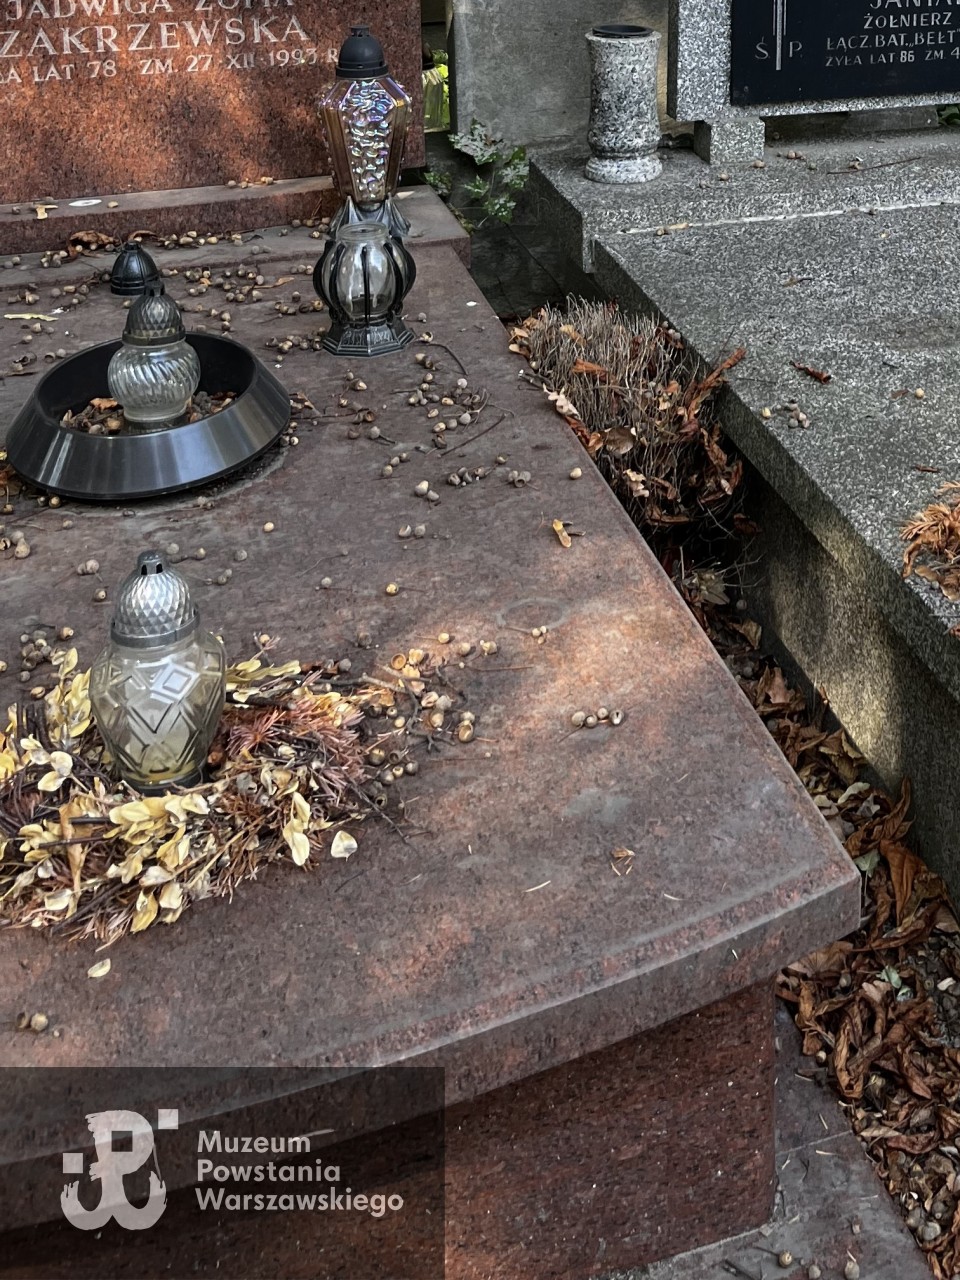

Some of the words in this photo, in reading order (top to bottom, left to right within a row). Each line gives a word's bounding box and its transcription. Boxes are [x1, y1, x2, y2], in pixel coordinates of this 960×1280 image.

[863, 11, 953, 30] ŻOŁNIERZ
[0, 14, 311, 58] ZAKRZEWSKA
[826, 34, 873, 53] ŁĄCZ.
[869, 51, 896, 65] LAT
[899, 49, 915, 64] 86
[32, 62, 76, 82] LAT
[86, 59, 118, 79] 78
[139, 57, 179, 76] ZM.
